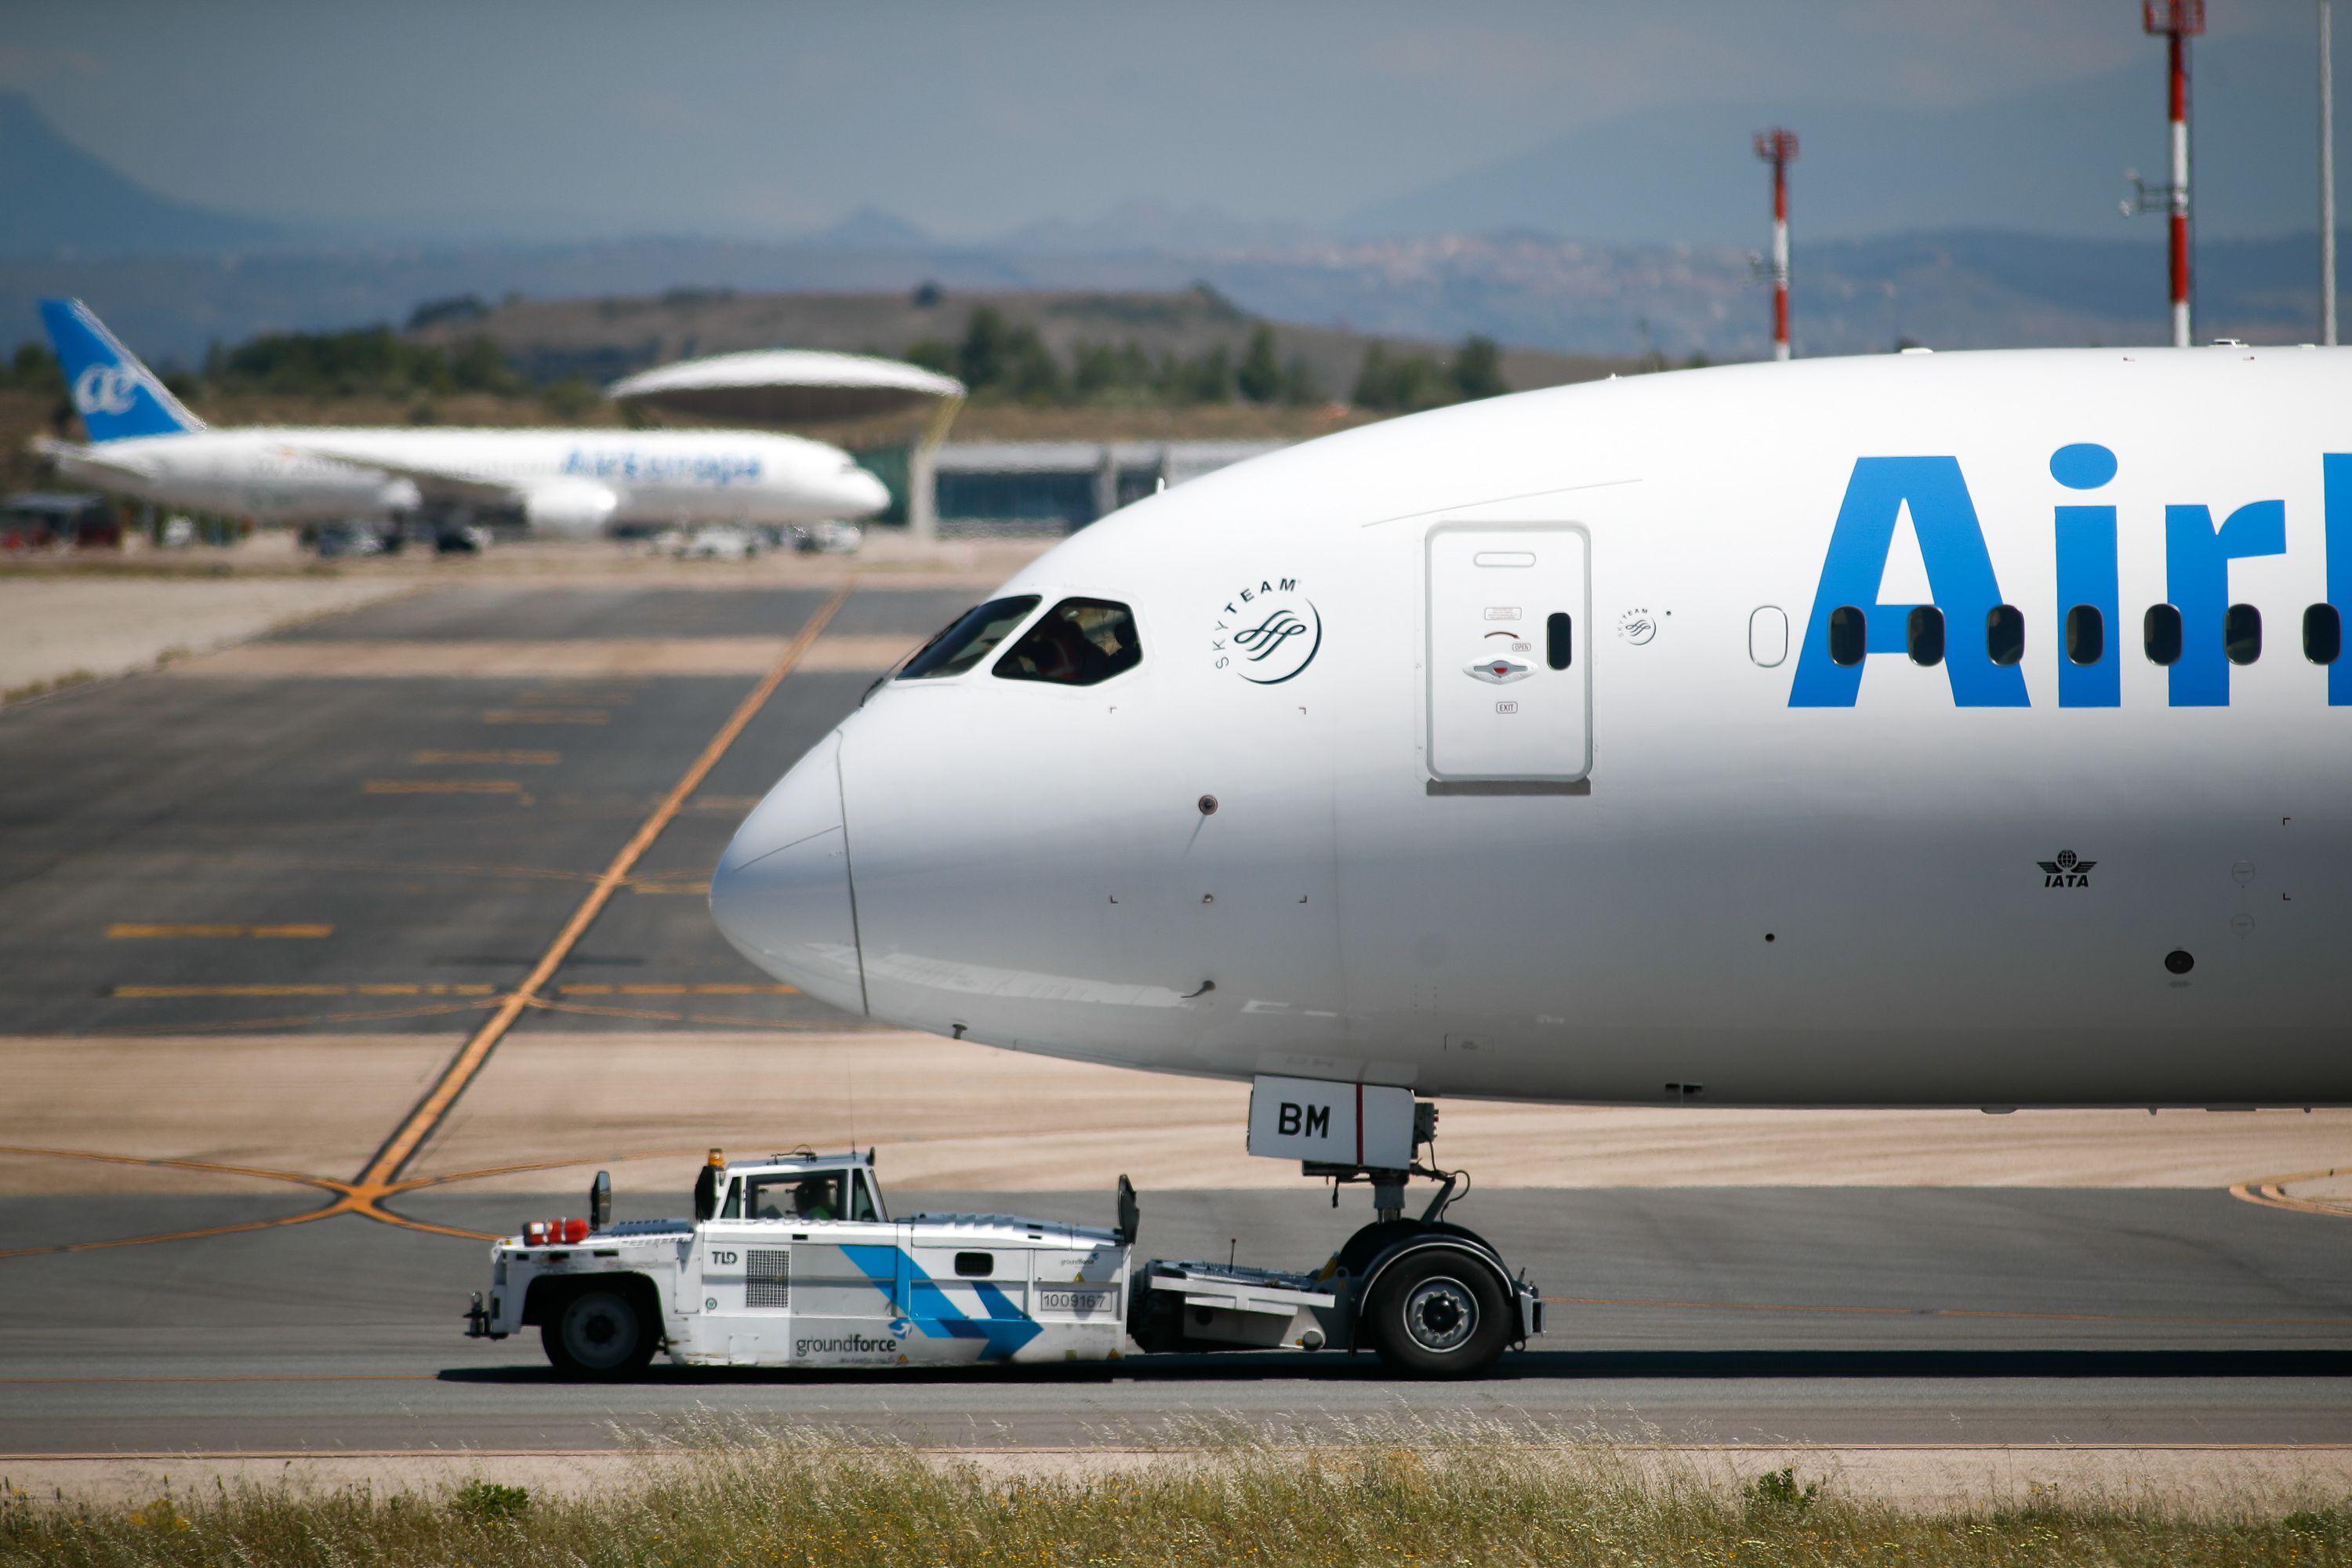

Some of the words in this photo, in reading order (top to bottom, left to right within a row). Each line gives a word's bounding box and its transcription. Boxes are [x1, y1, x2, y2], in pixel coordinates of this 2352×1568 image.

[1213, 578, 1297, 670] SKYTEAM
[1499, 703, 1514, 712] EXIT
[2044, 874, 2089, 888] IATA
[1278, 1102, 1330, 1139] BM
[712, 1251, 738, 1265] TLD
[1044, 1294, 1105, 1308] 1009167
[796, 1334, 897, 1358] groundforce
